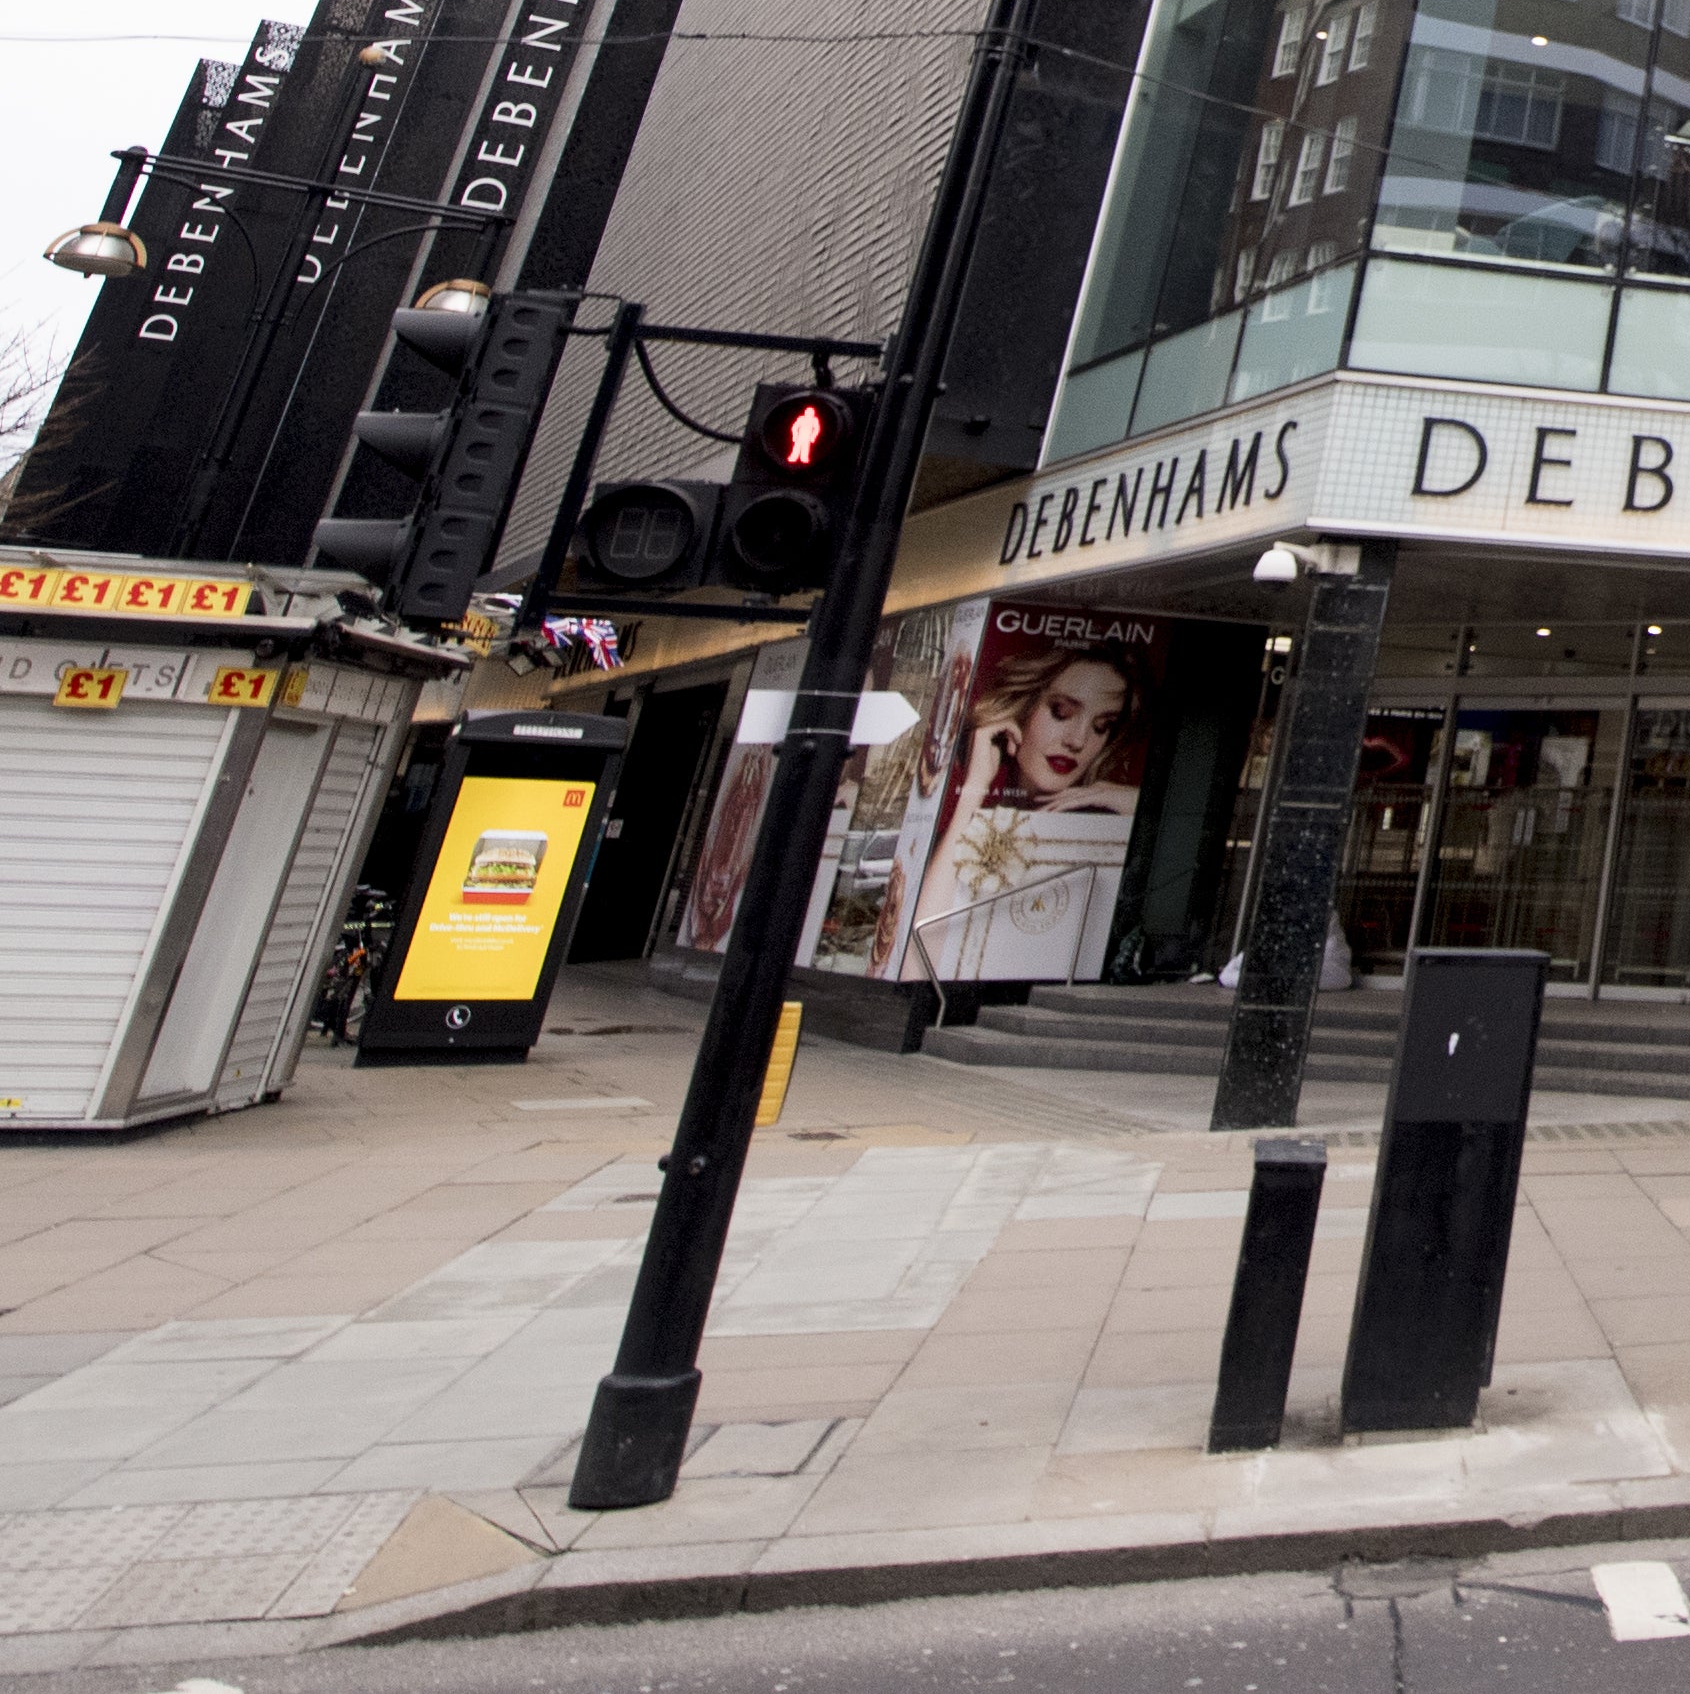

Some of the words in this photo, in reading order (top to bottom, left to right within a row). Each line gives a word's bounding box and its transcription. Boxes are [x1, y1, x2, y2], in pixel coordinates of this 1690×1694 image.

[139, 46, 290, 342] DEBENHAMS
[999, 420, 1298, 566] DEBENHAMS
[60, 575, 112, 605] £1
[125, 581, 176, 609] £1
[191, 584, 240, 612] £1
[996, 609, 1155, 644] GUERLAIN
[65, 672, 116, 699] £1
[218, 671, 267, 700] £1
